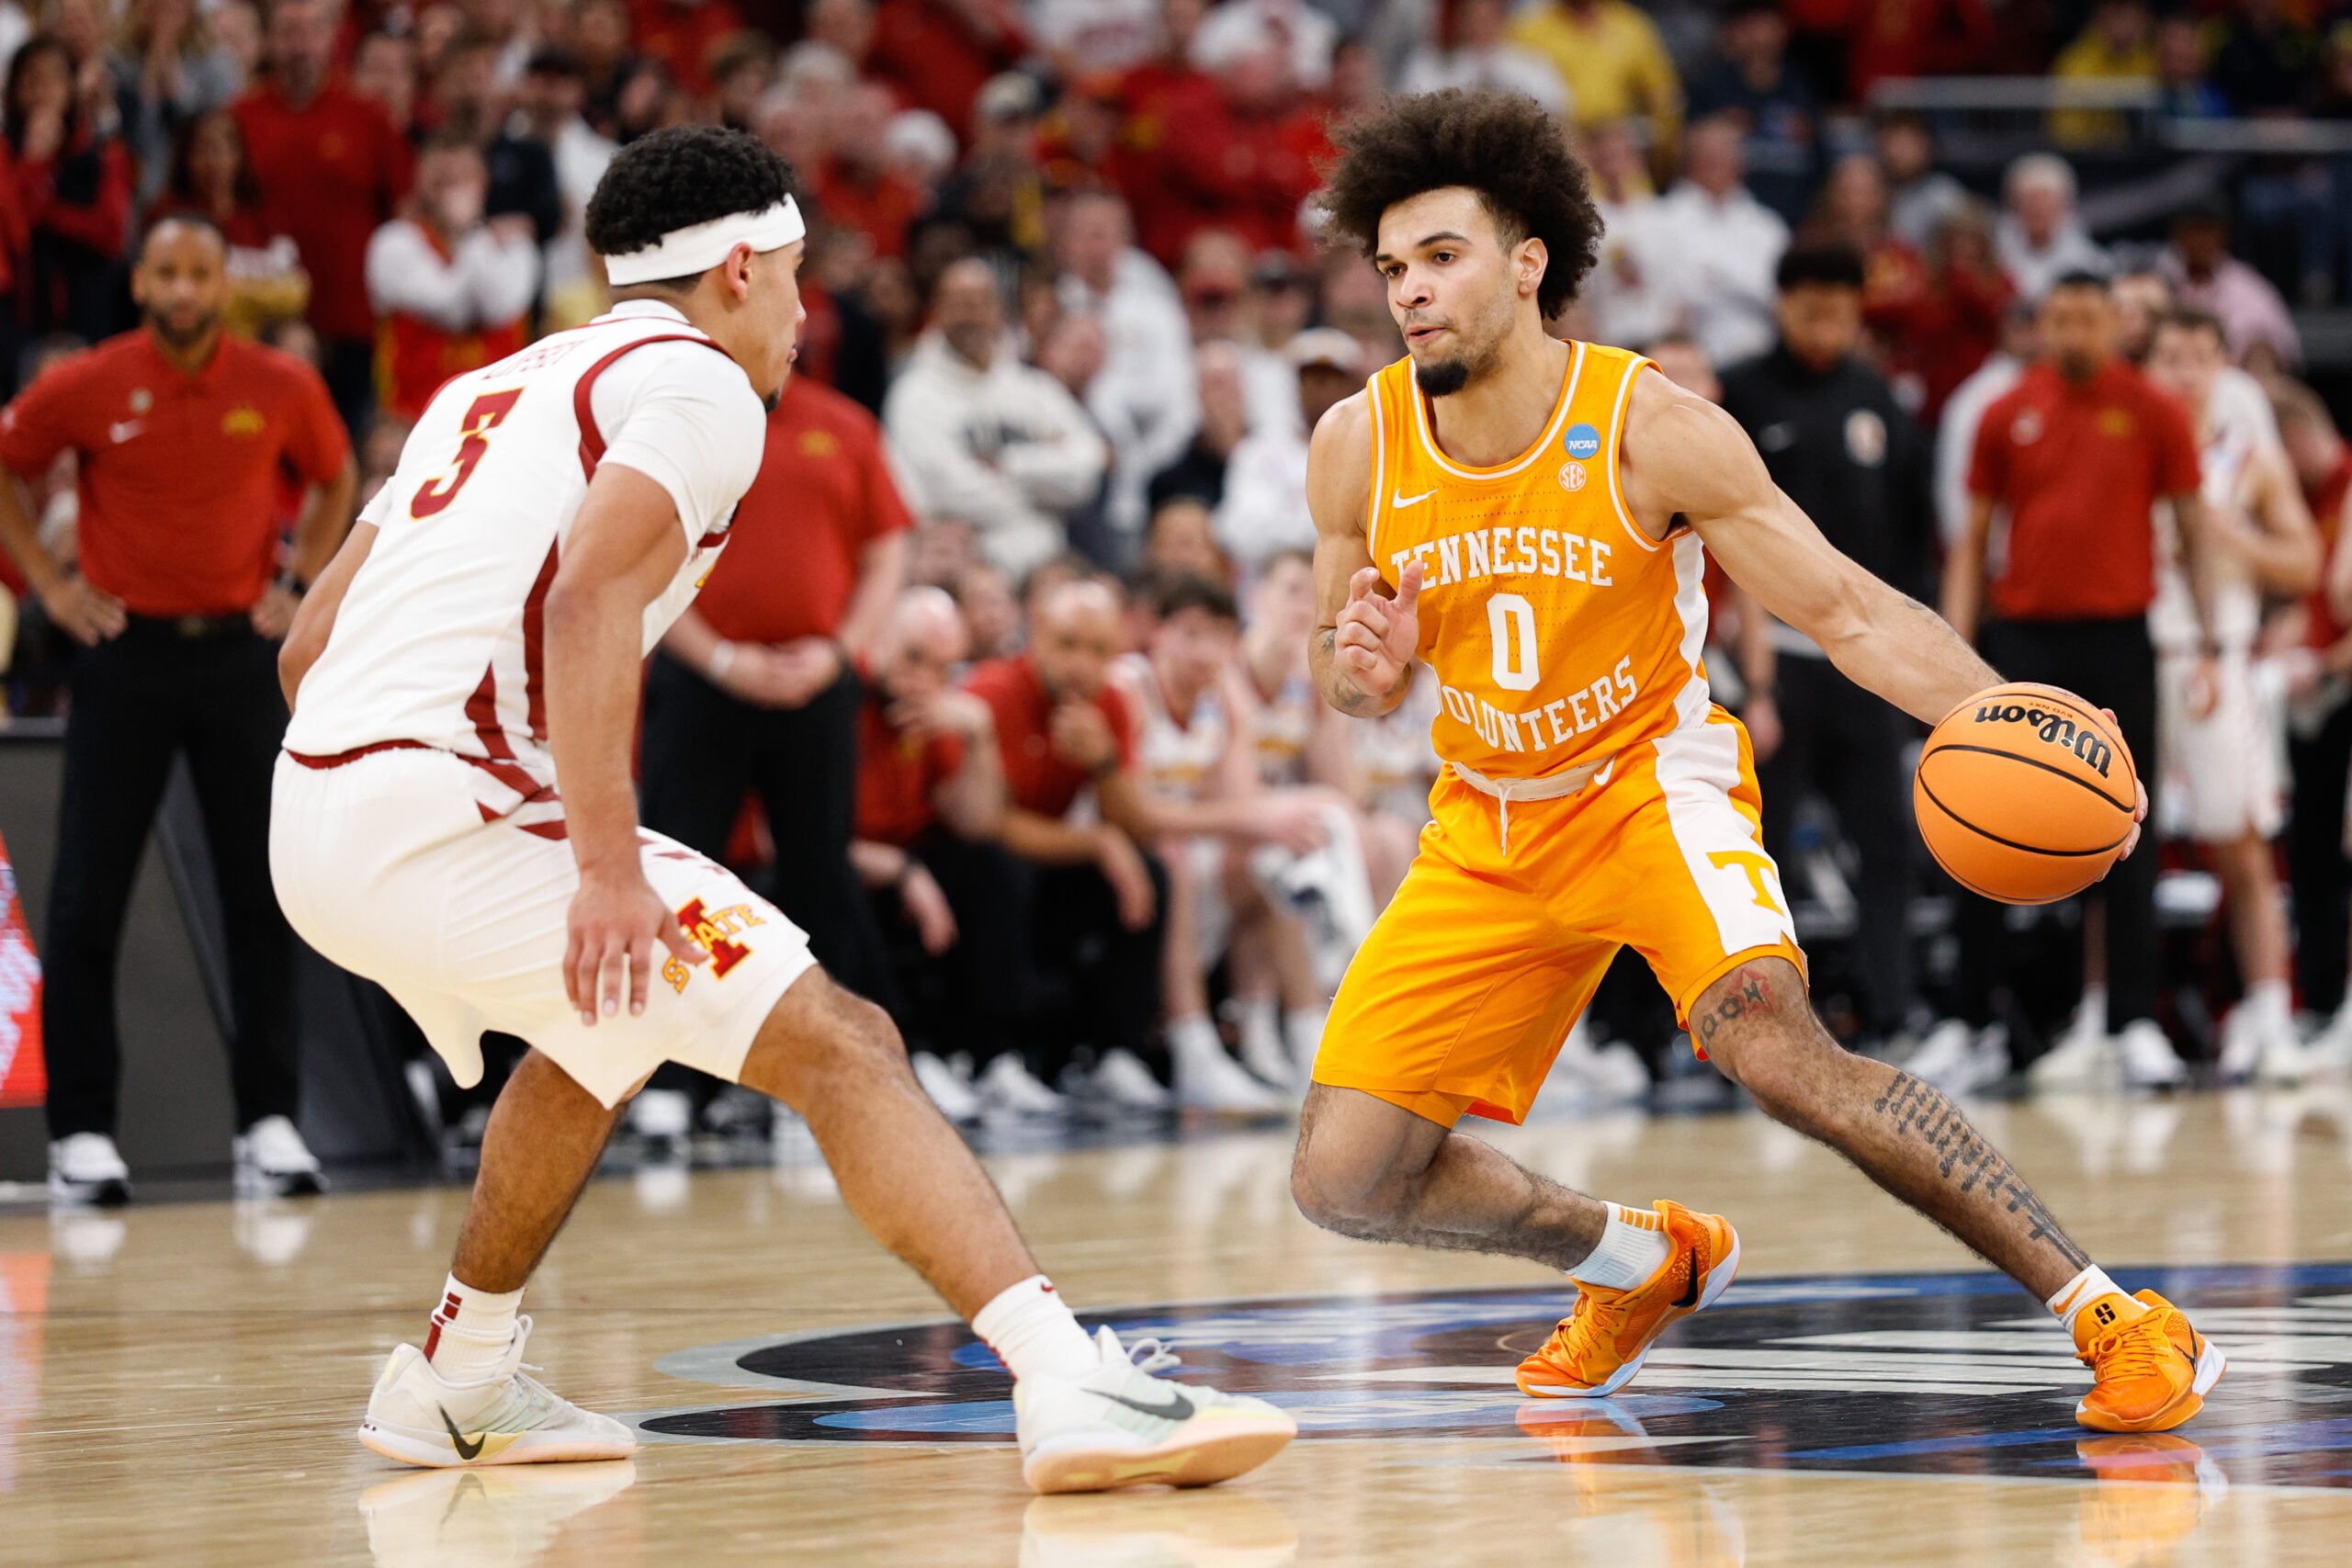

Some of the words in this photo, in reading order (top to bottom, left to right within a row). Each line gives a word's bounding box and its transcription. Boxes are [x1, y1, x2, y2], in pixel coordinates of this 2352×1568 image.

[409, 384, 526, 522] 3
[1561, 463, 1585, 490] SEC
[1568, 439, 1598, 450] NCAA
[1390, 526, 1613, 591] TENNESSEE
[1486, 592, 1541, 692] 0
[1435, 654, 1638, 753] OLUNTEERS
[1974, 705, 2111, 779] Wilson
[1705, 851, 1786, 918] T
[662, 904, 767, 994] SATE
